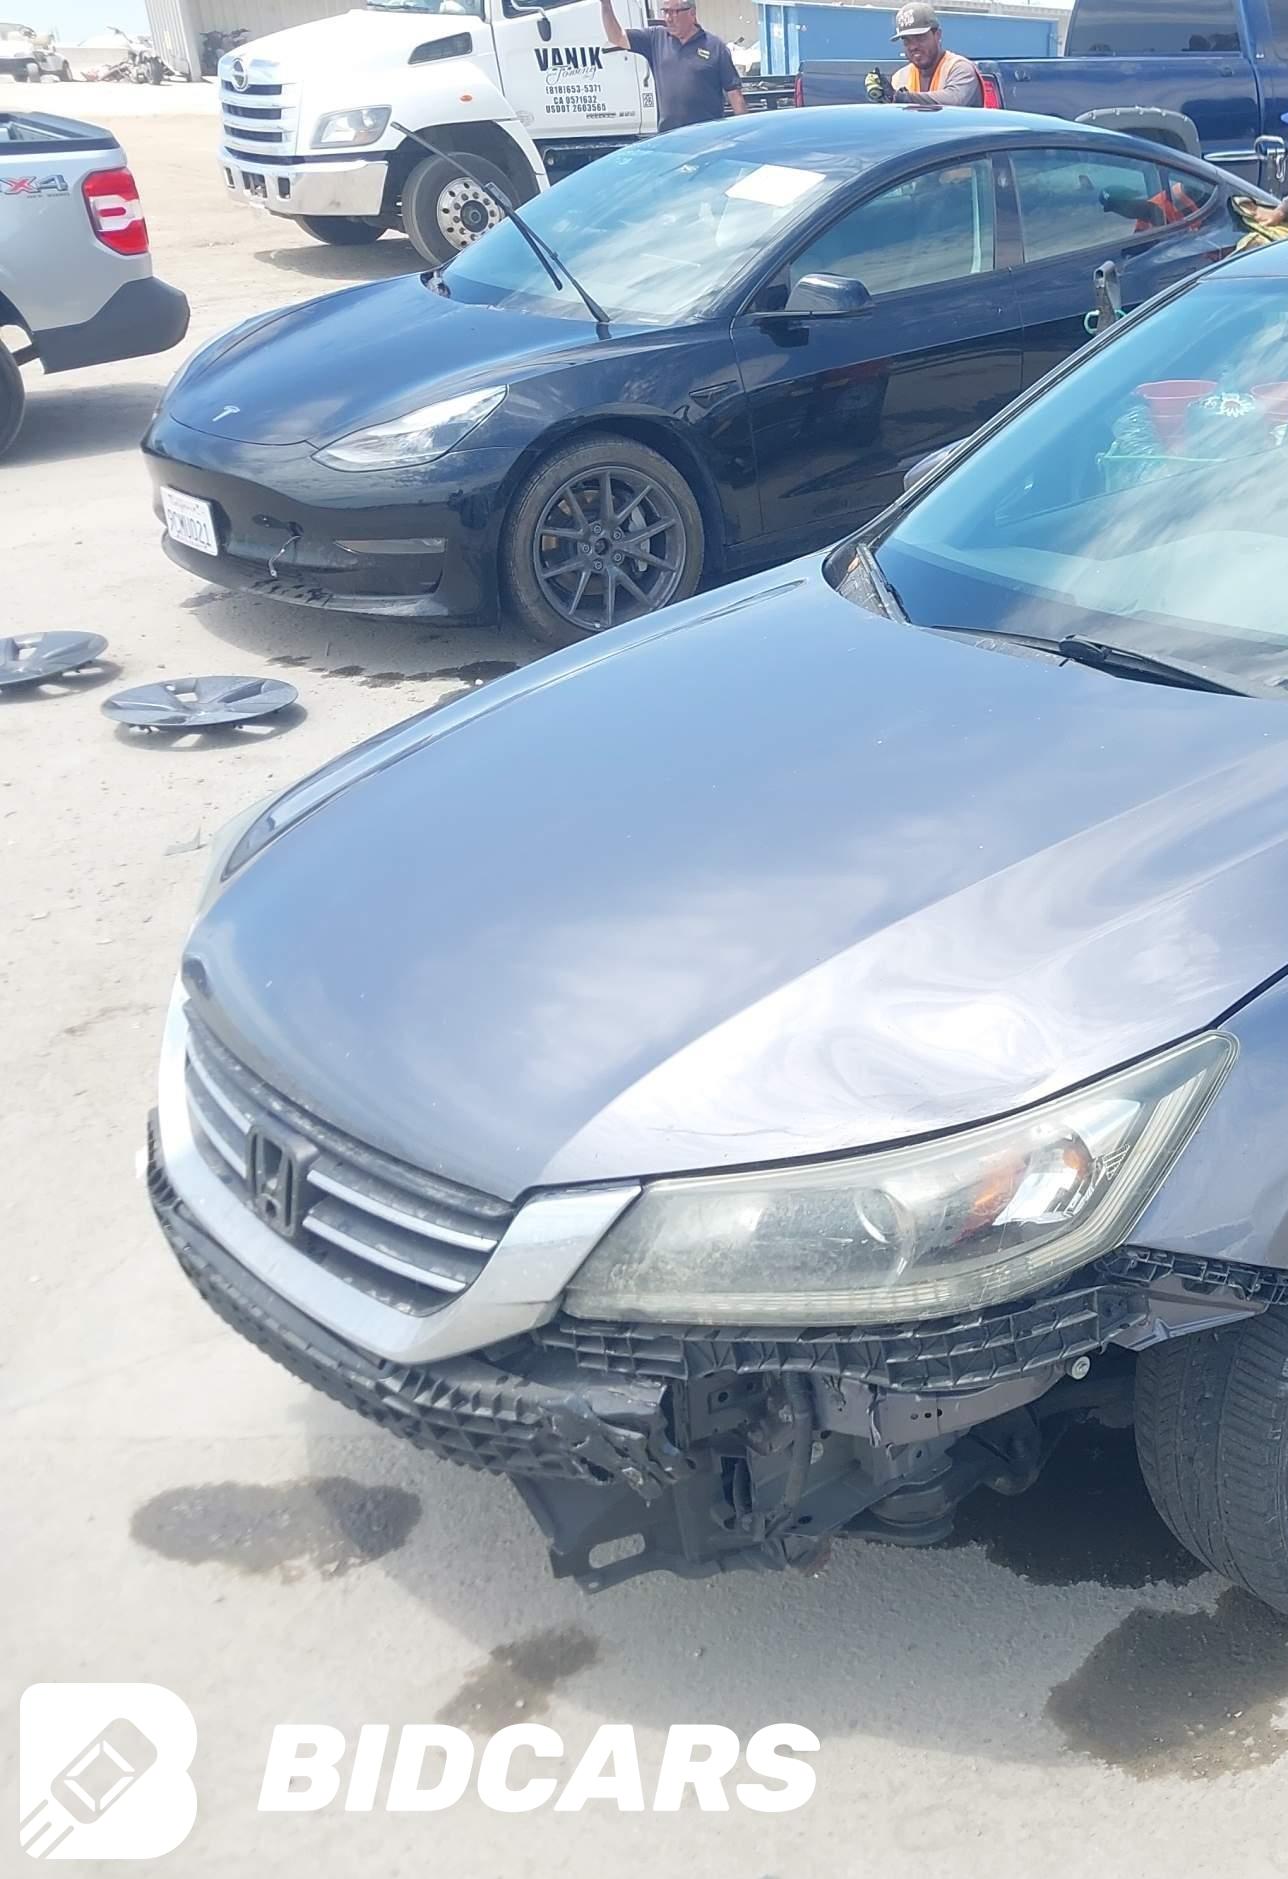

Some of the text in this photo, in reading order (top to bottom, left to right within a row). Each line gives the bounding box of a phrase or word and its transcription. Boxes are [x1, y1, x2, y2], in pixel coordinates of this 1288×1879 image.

[534, 46, 603, 71] VANIK
[546, 64, 597, 85] Towing
[545, 104, 571, 113] USDOT
[553, 97, 564, 105] CA
